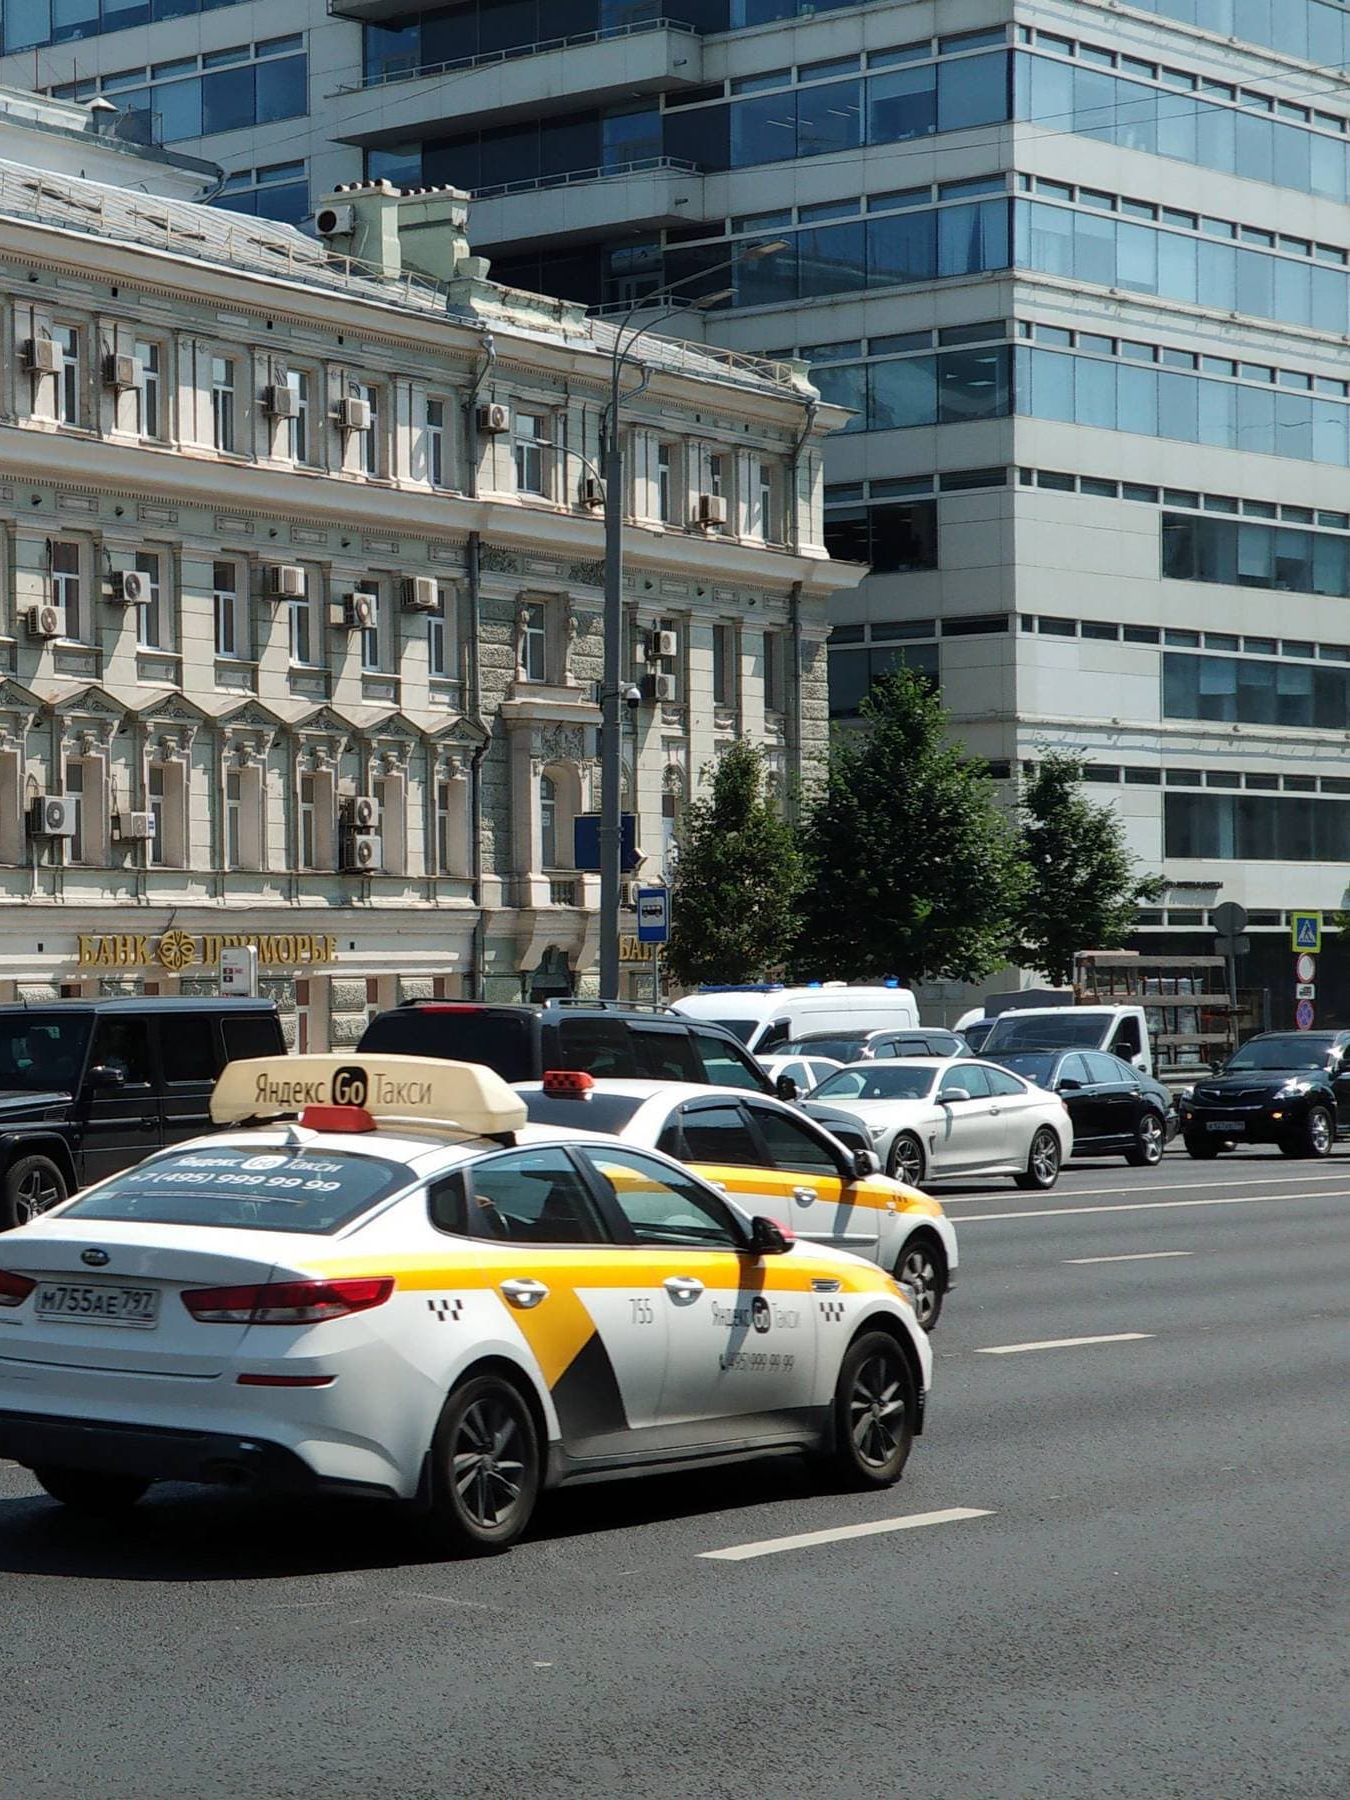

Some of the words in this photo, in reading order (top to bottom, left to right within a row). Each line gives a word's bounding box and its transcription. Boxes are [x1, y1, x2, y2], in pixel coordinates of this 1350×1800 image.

[77, 934, 152, 966] БАНК
[254, 1072, 326, 1107] Яндекс
[334, 1071, 366, 1105] Go
[373, 1073, 433, 1105] Такси
[172, 1155, 244, 1168] Яндекс
[283, 1158, 345, 1173] Такси
[152, 1172, 214, 1185] (495)
[217, 1174, 266, 1186] 999
[265, 1176, 303, 1189] 99
[302, 1180, 342, 1193] 99
[628, 1297, 654, 1325] 755
